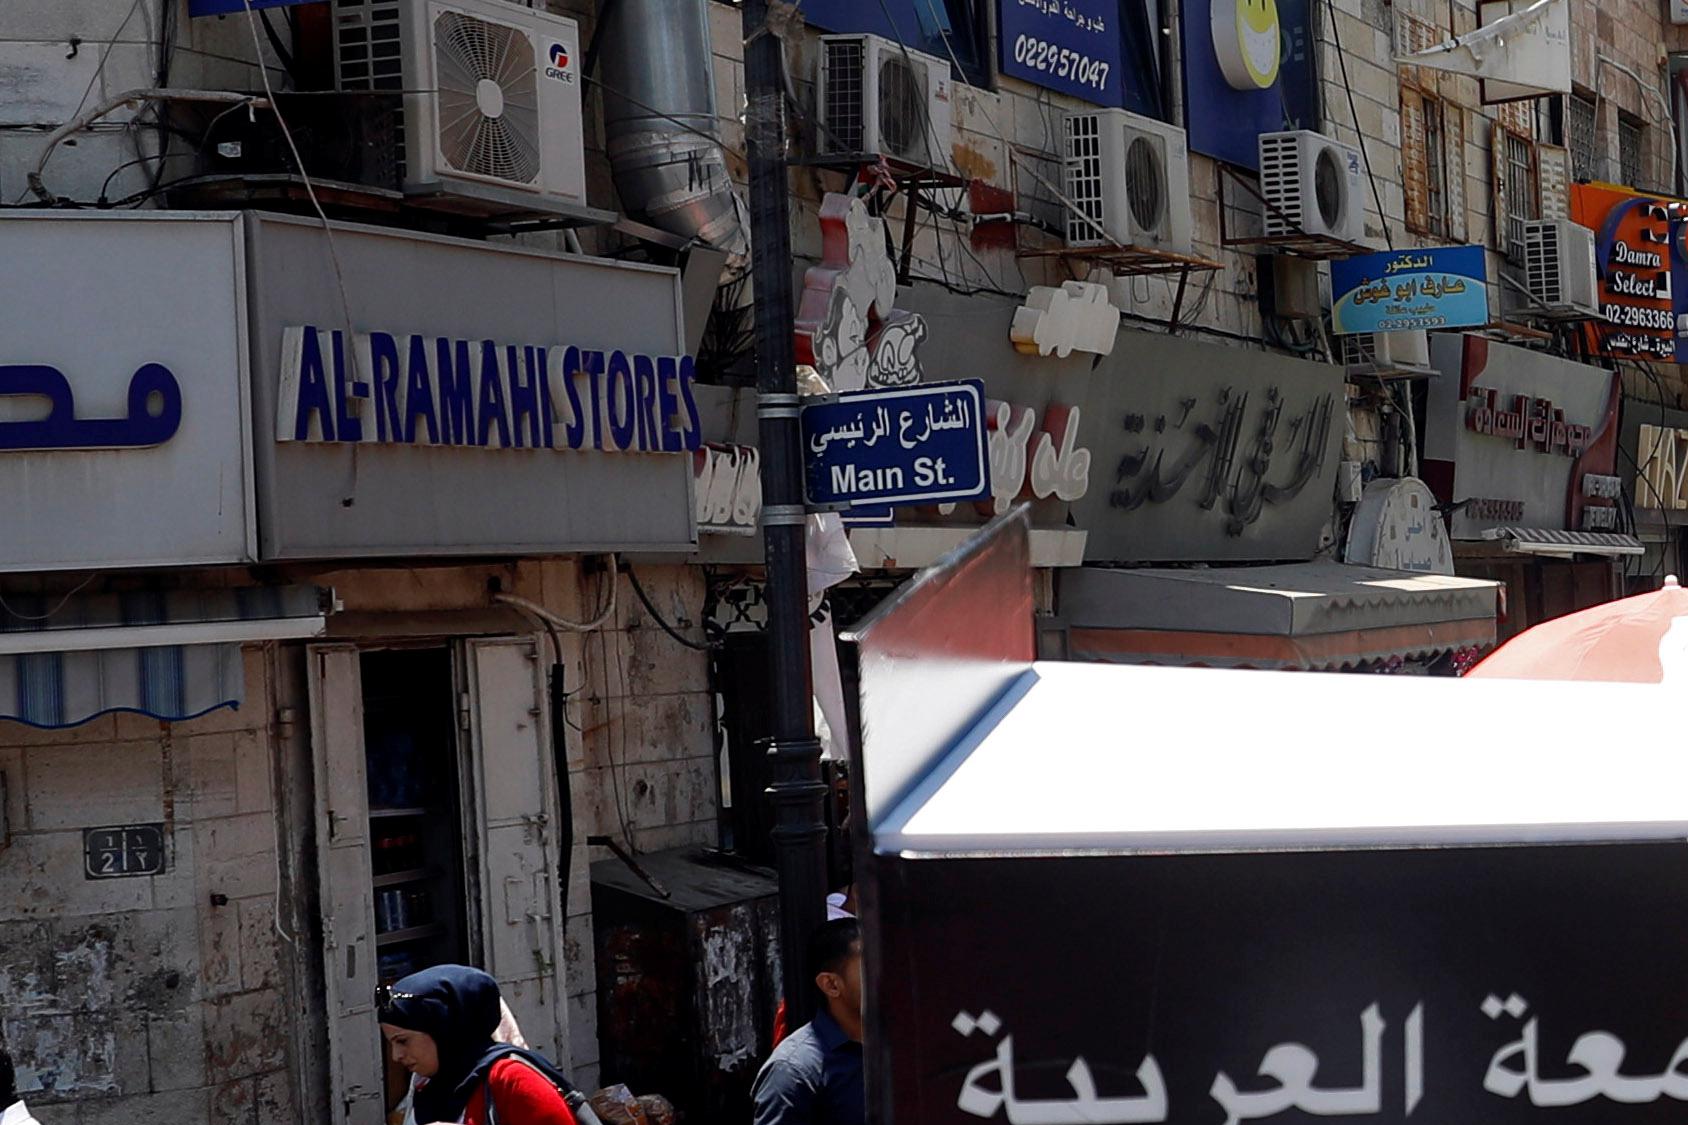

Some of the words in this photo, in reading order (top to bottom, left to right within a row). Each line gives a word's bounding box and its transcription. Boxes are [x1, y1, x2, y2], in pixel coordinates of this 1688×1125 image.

[545, 67, 573, 83] GREE
[1015, 34, 1110, 91] 022957047
[1384, 255, 1433, 272] الدكتور
[1615, 240, 1661, 268] Damra
[1421, 275, 1465, 298] عارف
[1613, 271, 1655, 296] Select
[1606, 304, 1674, 330] 02-2963366
[287, 325, 554, 448] AL-RAMAHI
[560, 344, 702, 453] STORES
[811, 406, 890, 457] الرئيسي
[900, 395, 970, 449] الشارع
[831, 464, 904, 495] Main
[914, 457, 955, 487] St.
[101, 852, 114, 872] 2
